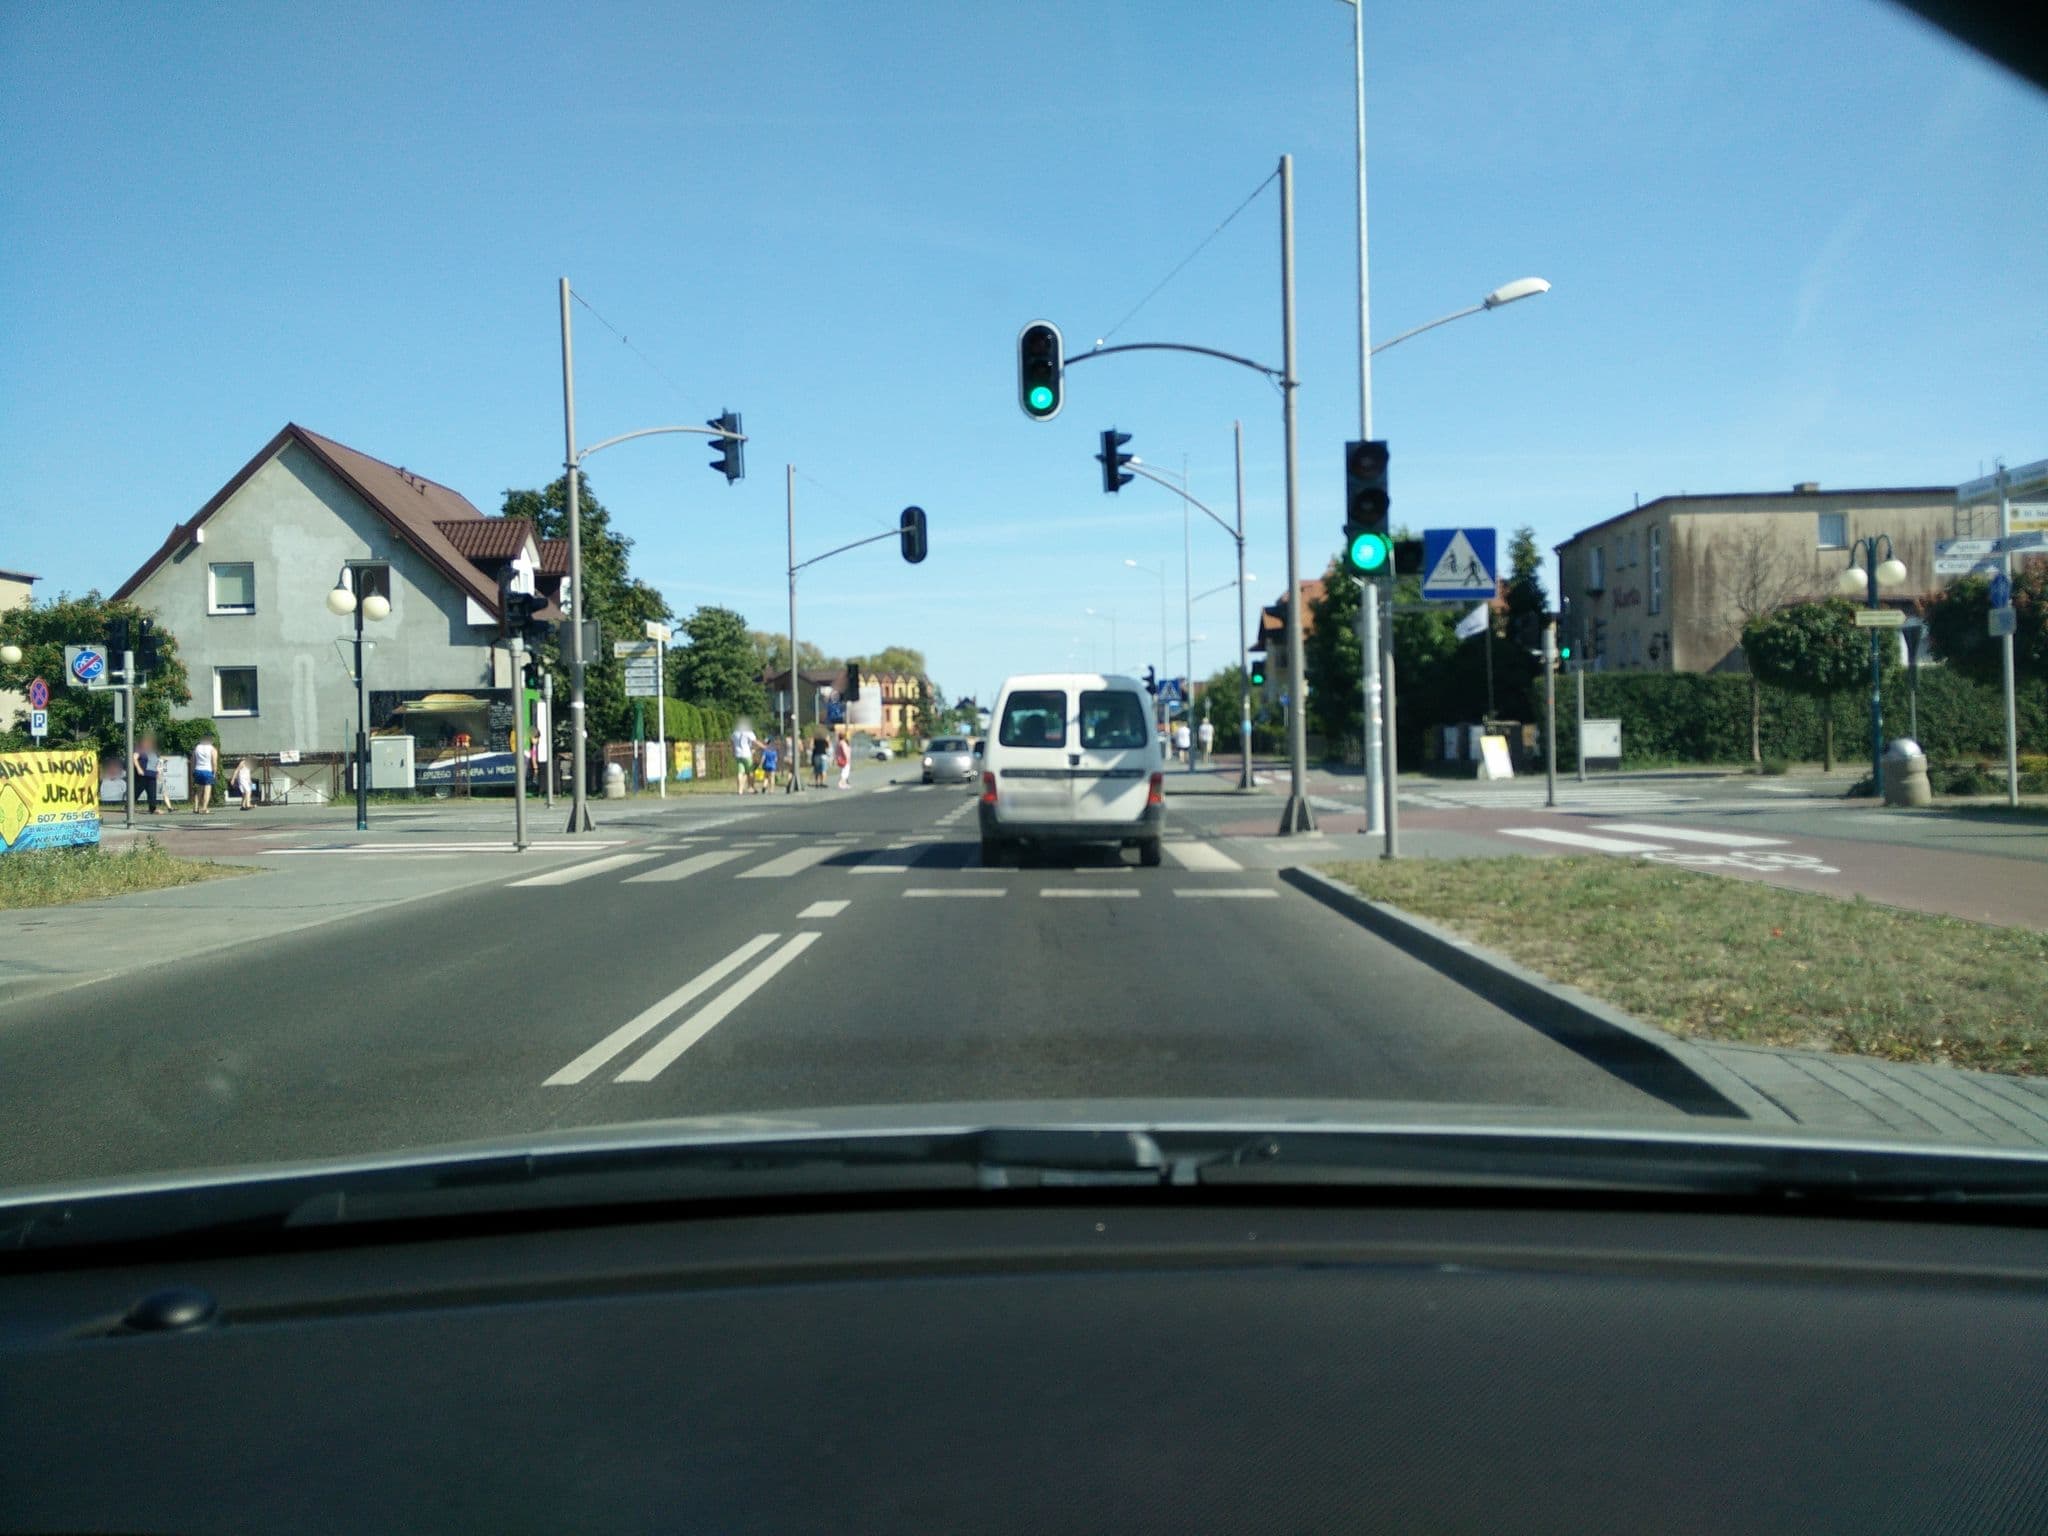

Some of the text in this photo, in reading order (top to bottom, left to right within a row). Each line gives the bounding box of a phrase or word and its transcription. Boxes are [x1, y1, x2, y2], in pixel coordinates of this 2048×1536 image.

[35, 714, 44, 728] P
[42, 784, 95, 805] JURATA
[37, 813, 56, 823] 607
